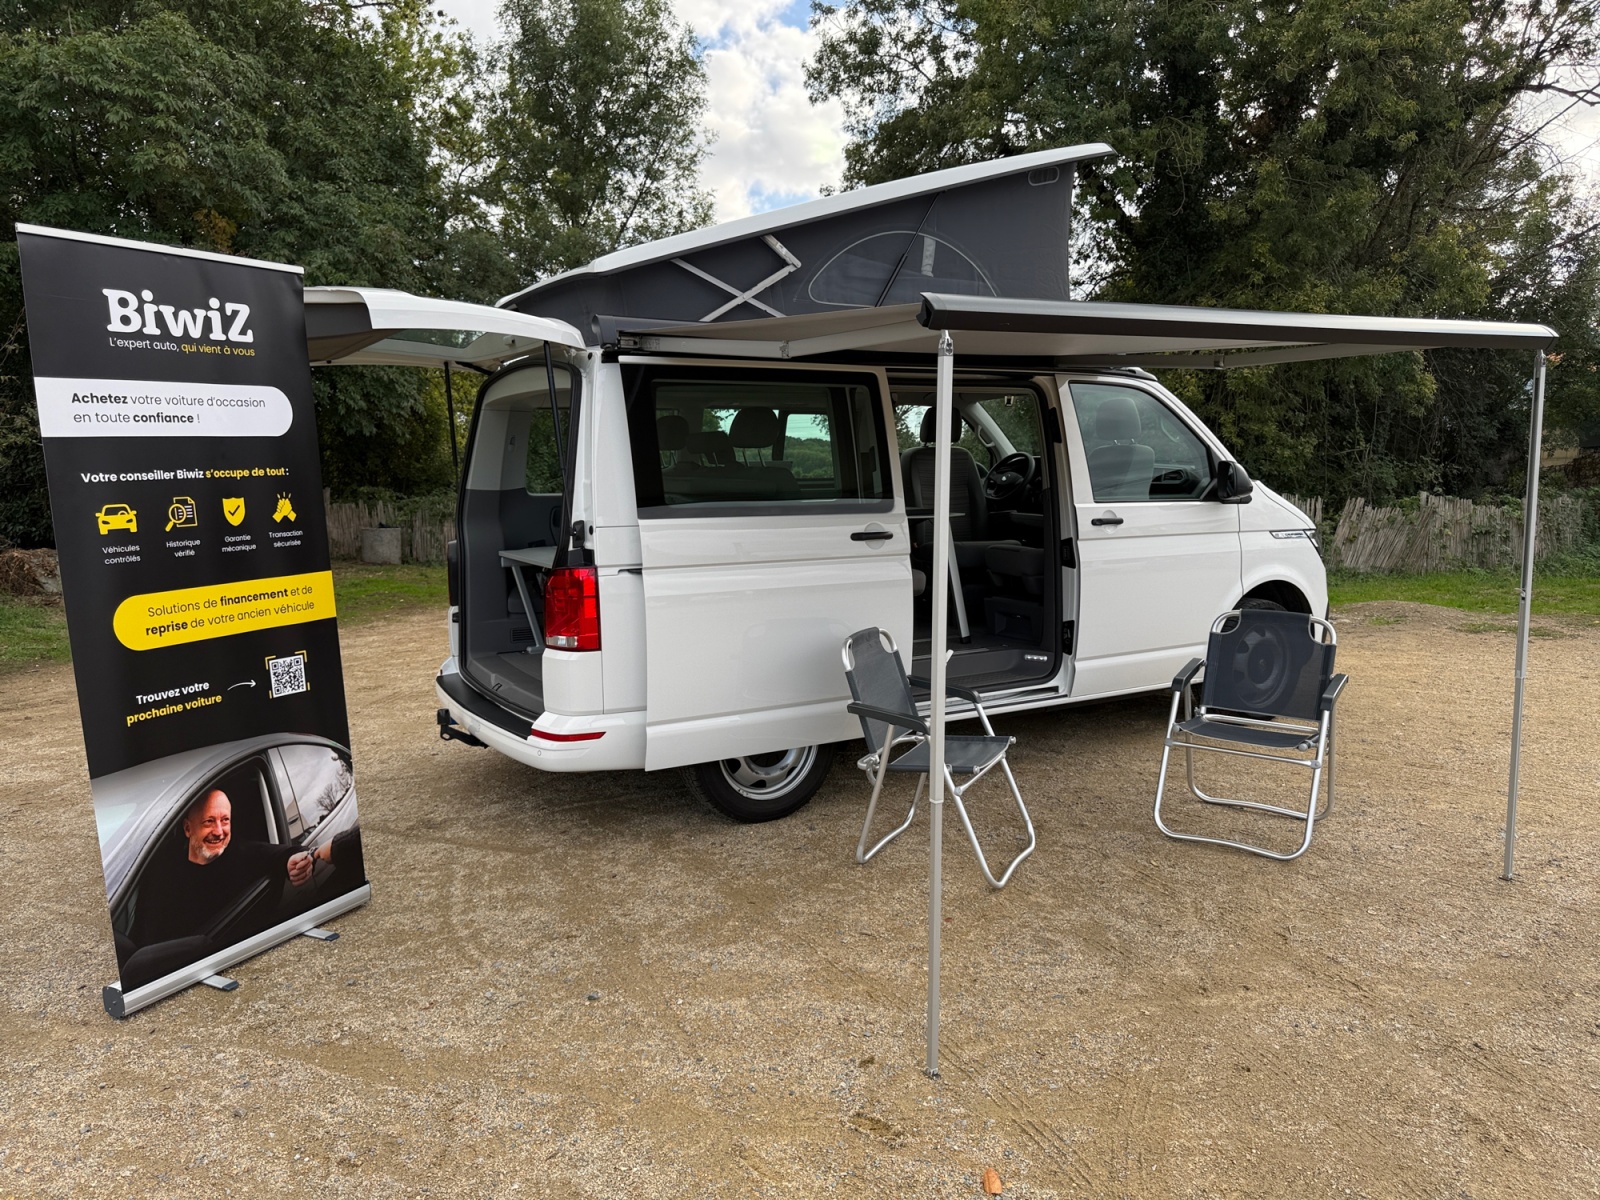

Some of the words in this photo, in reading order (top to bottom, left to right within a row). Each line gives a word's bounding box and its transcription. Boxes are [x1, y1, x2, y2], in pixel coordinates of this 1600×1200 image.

[102, 288, 254, 343] BiwiZ
[109, 337, 151, 350] L'expert
[153, 341, 179, 352] auto,
[181, 342, 197, 354] qui
[198, 344, 221, 355] vient
[223, 345, 231, 355] à
[232, 347, 255, 356] vous
[71, 392, 128, 404] Achetez
[130, 394, 162, 405] votre
[164, 395, 204, 406] voiture
[206, 396, 266, 408] d'occasion
[73, 413, 92, 423] en
[95, 412, 131, 423] toute
[133, 412, 194, 424] confiance
[81, 472, 117, 483] Votre
[119, 469, 174, 482] conseiller
[176, 468, 204, 480] Biwiz
[205, 468, 250, 480] s'occupe
[252, 467, 265, 477] de
[224, 534, 251, 543] Garantie
[268, 529, 303, 539] Transaction
[102, 544, 140, 554] Véhicules
[166, 538, 201, 549] Historique
[221, 543, 257, 553] mécanique
[273, 539, 302, 548] sécurisée
[174, 549, 195, 558] vérifié
[104, 555, 141, 565] contrôlés
[147, 601, 201, 618] Solutions
[203, 598, 218, 610] de
[220, 588, 289, 607] financement
[290, 586, 300, 597] et
[302, 585, 313, 595] de
[145, 621, 188, 637] reprise
[190, 617, 205, 629] de
[207, 614, 235, 626] votre
[237, 607, 271, 621] ancien
[273, 600, 315, 615] véhicule
[136, 687, 180, 705] Trouvez
[181, 680, 210, 694] votre
[126, 702, 183, 727] prochaine
[185, 694, 222, 711] voiture
